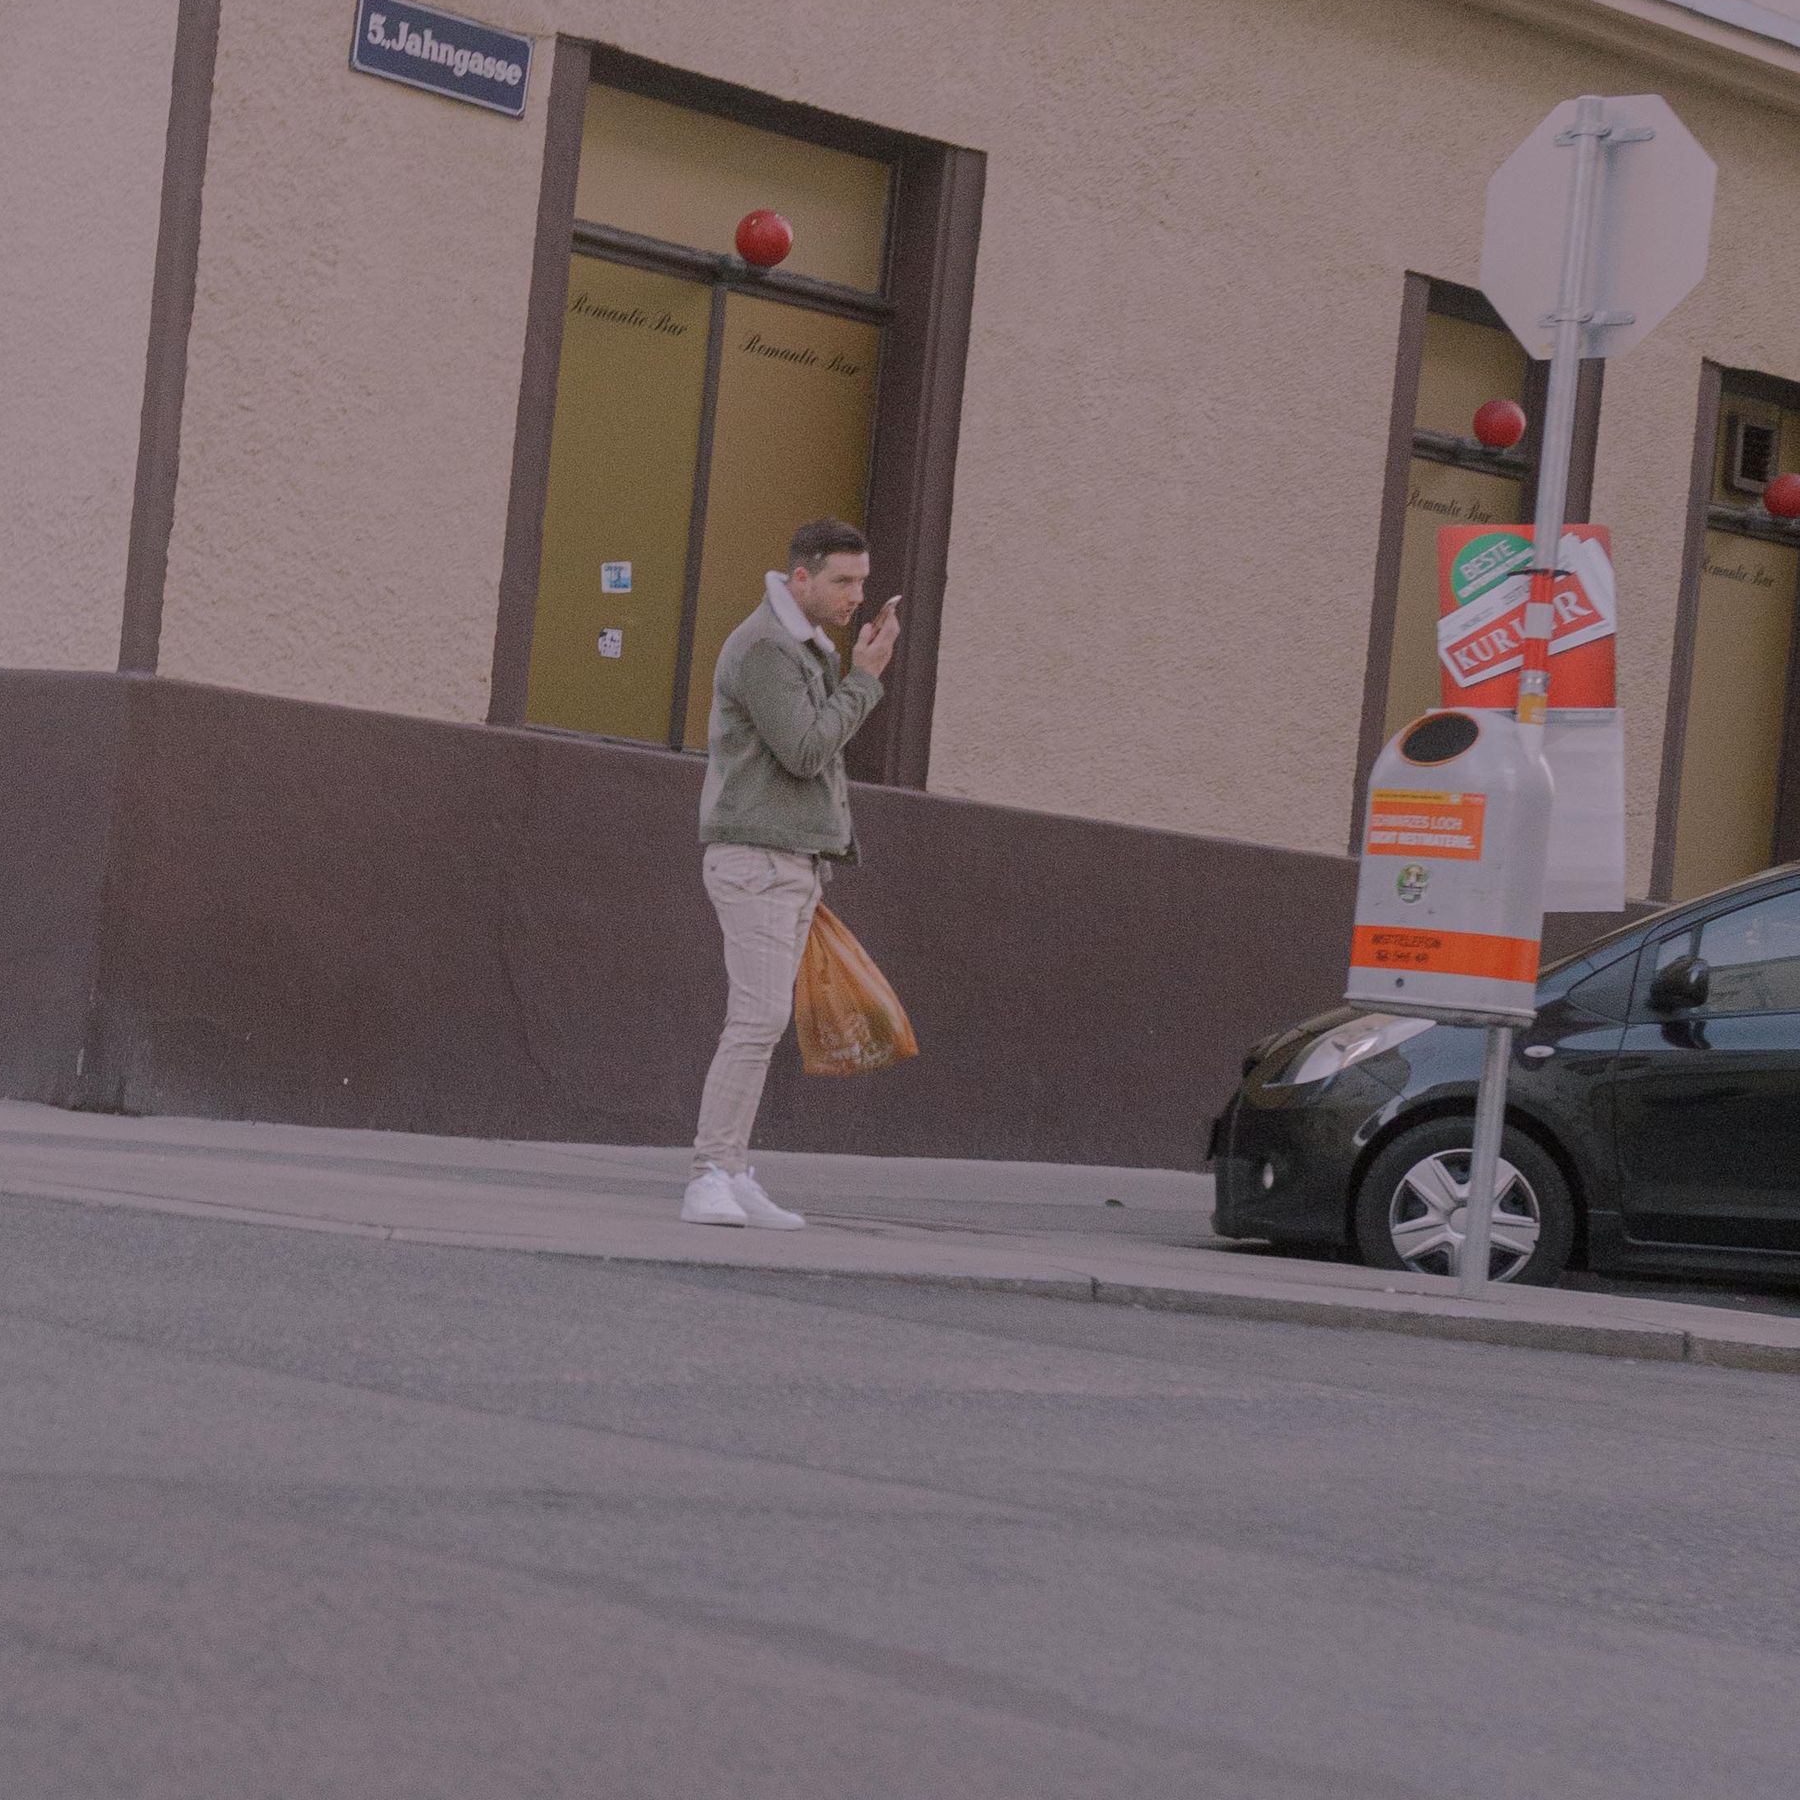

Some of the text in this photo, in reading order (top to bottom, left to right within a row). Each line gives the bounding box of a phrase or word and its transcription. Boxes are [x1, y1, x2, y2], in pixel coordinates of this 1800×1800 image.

[569, 292, 688, 336] Romantic Bar
[743, 334, 860, 377] Romantic Bar
[1459, 538, 1518, 581] BESTE
